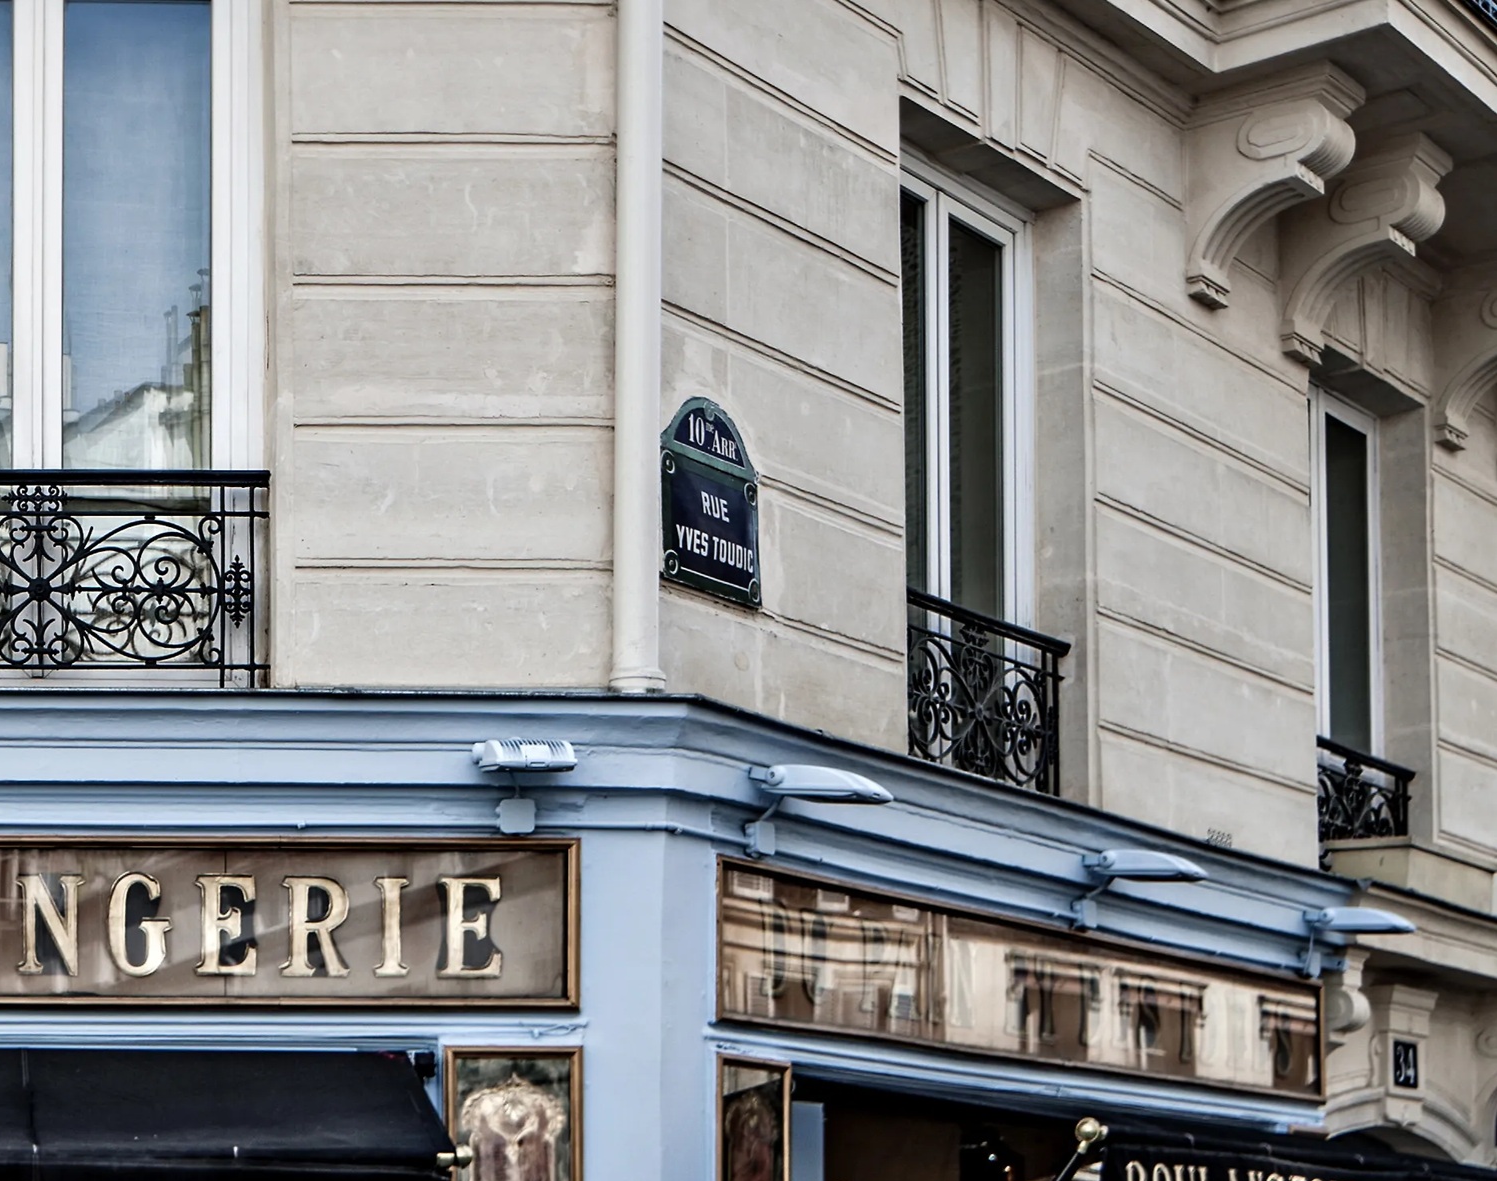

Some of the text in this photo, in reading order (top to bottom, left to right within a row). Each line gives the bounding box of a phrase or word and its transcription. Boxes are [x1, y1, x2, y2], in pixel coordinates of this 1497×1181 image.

[701, 491, 730, 523] RUE
[676, 523, 754, 573] YVES TOUDIC
[1396, 1045, 1415, 1084] 34
